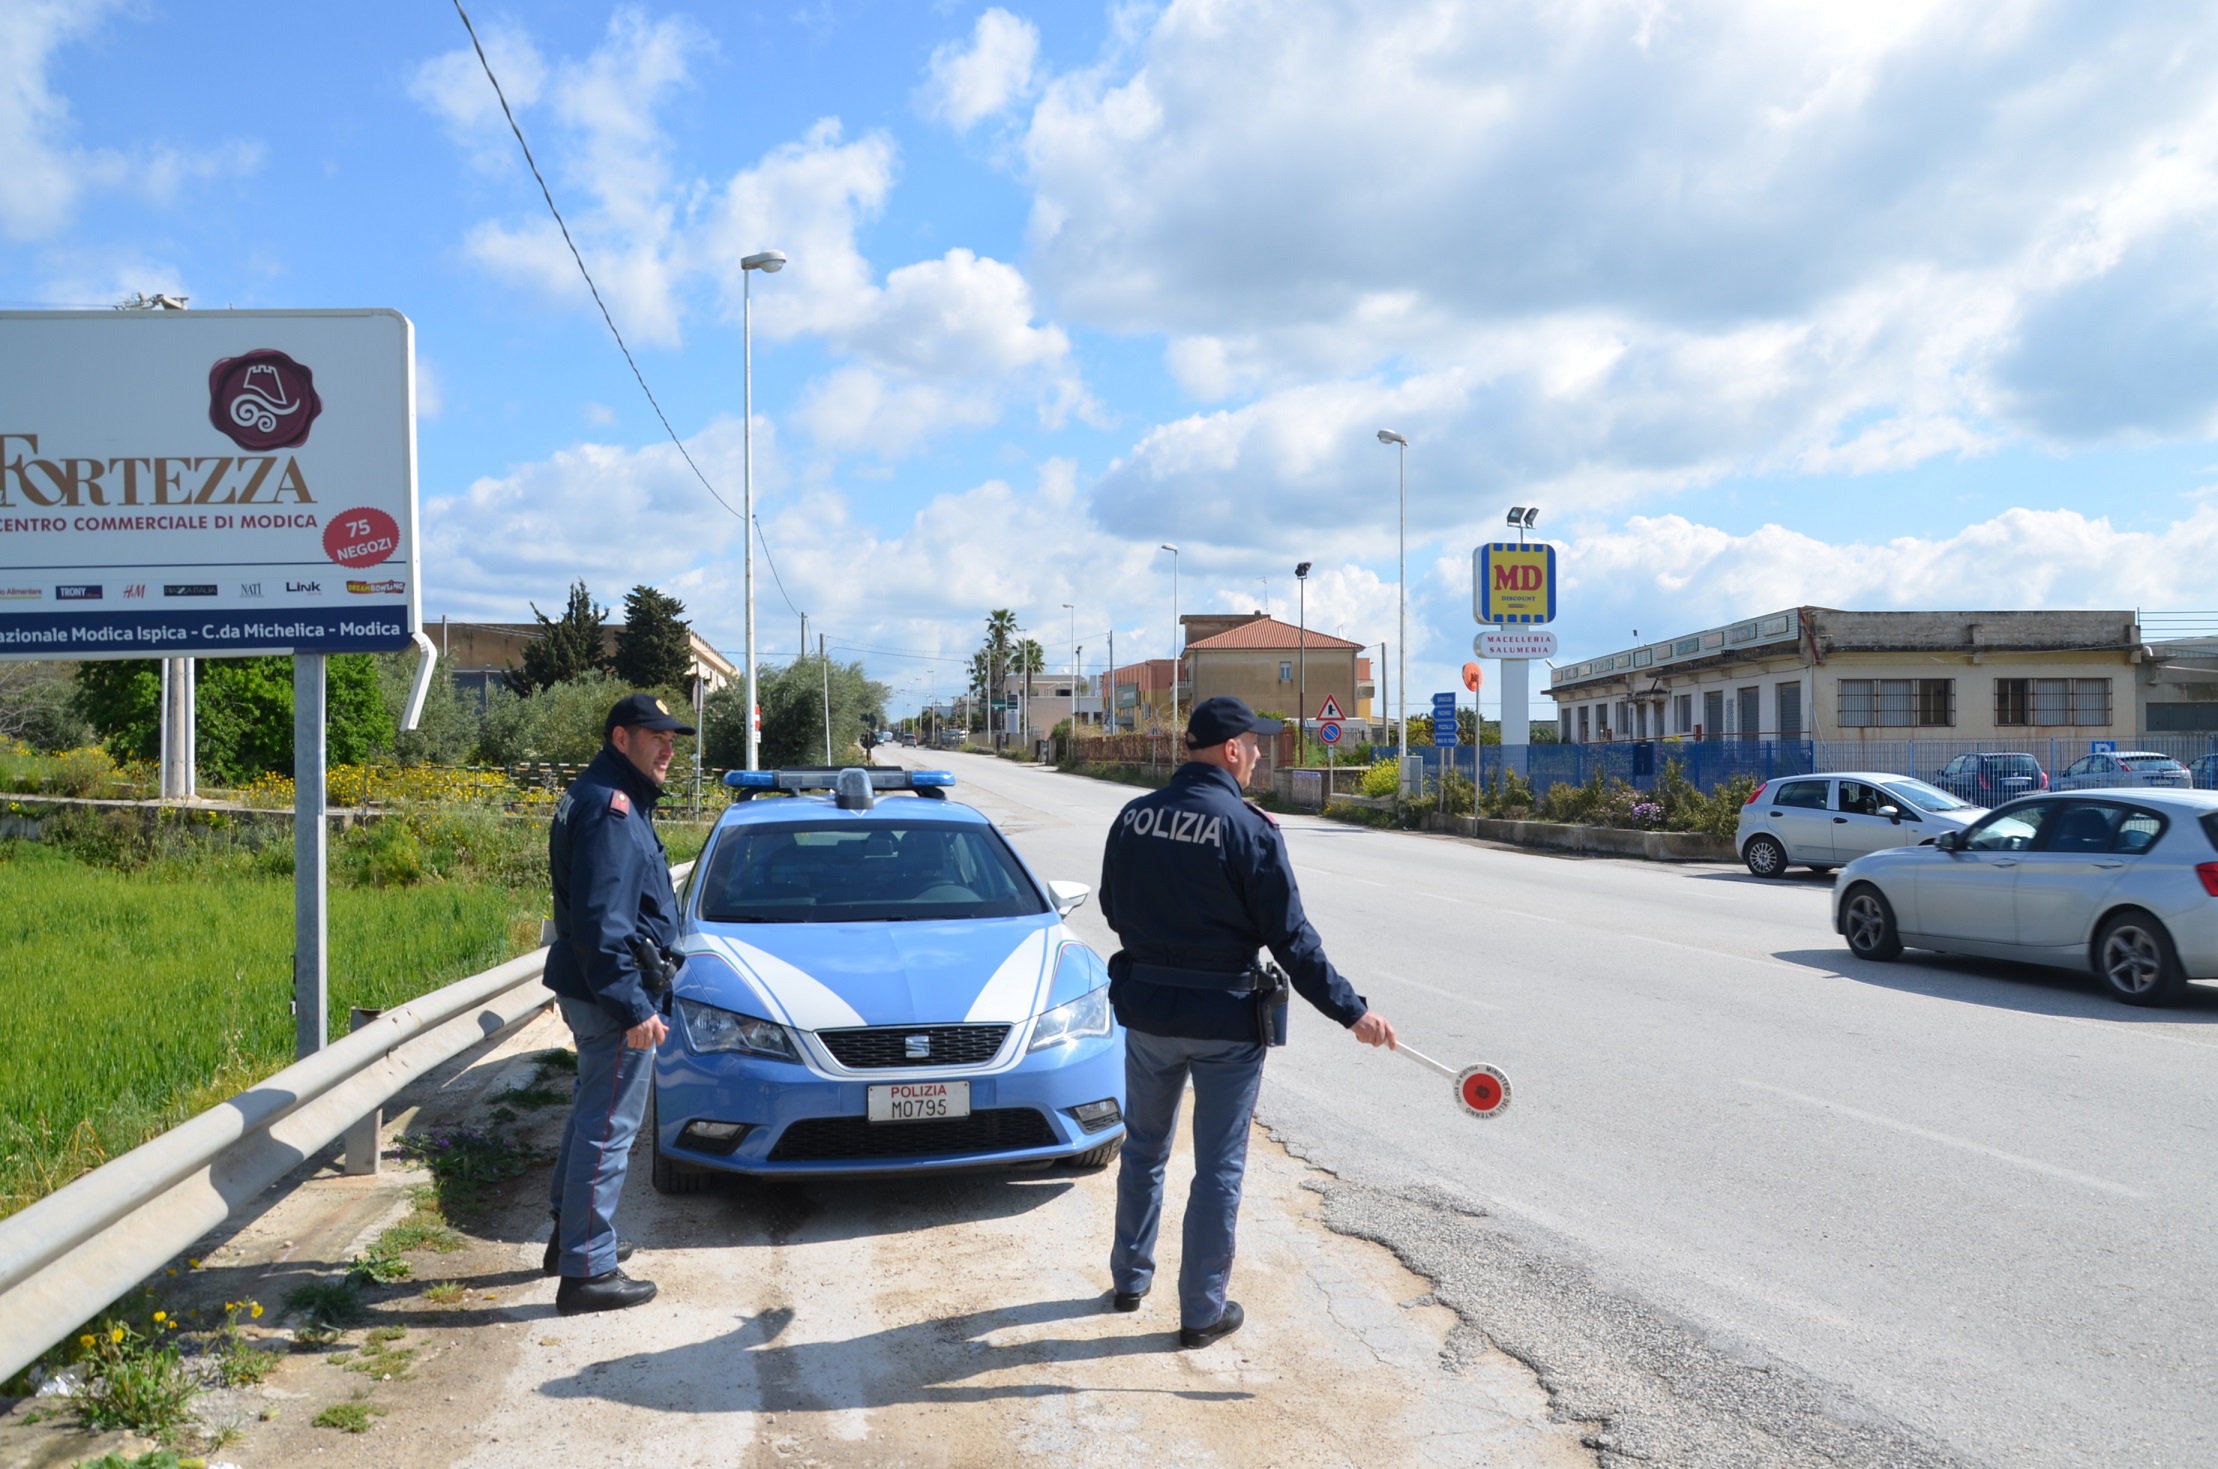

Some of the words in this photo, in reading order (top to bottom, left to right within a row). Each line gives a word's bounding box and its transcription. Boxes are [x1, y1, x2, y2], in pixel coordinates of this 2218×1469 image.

[0, 434, 318, 507] FORTEZZA
[0, 517, 67, 532] ENTRO
[74, 515, 207, 531] COMMERCIALE
[215, 515, 233, 529] DI
[241, 514, 318, 529] MODICA
[345, 519, 371, 538] 75
[336, 537, 393, 561] NEGOZI
[1494, 564, 1543, 591] MD
[60, 587, 86, 597] TRONY
[123, 584, 145, 599] H&M
[71, 626, 133, 642] Modica
[137, 625, 187, 643] Ispica
[202, 624, 240, 639] C.da
[244, 622, 325, 638] Michelica
[340, 622, 401, 637] Modica
[1120, 807, 1222, 848] POLIZIA
[1459, 1065, 1478, 1079] POLIZIA
[1486, 1066, 1511, 1097] MINISTERO
[891, 1084, 947, 1098] POLIZIA
[891, 1099, 947, 1119] M0795
